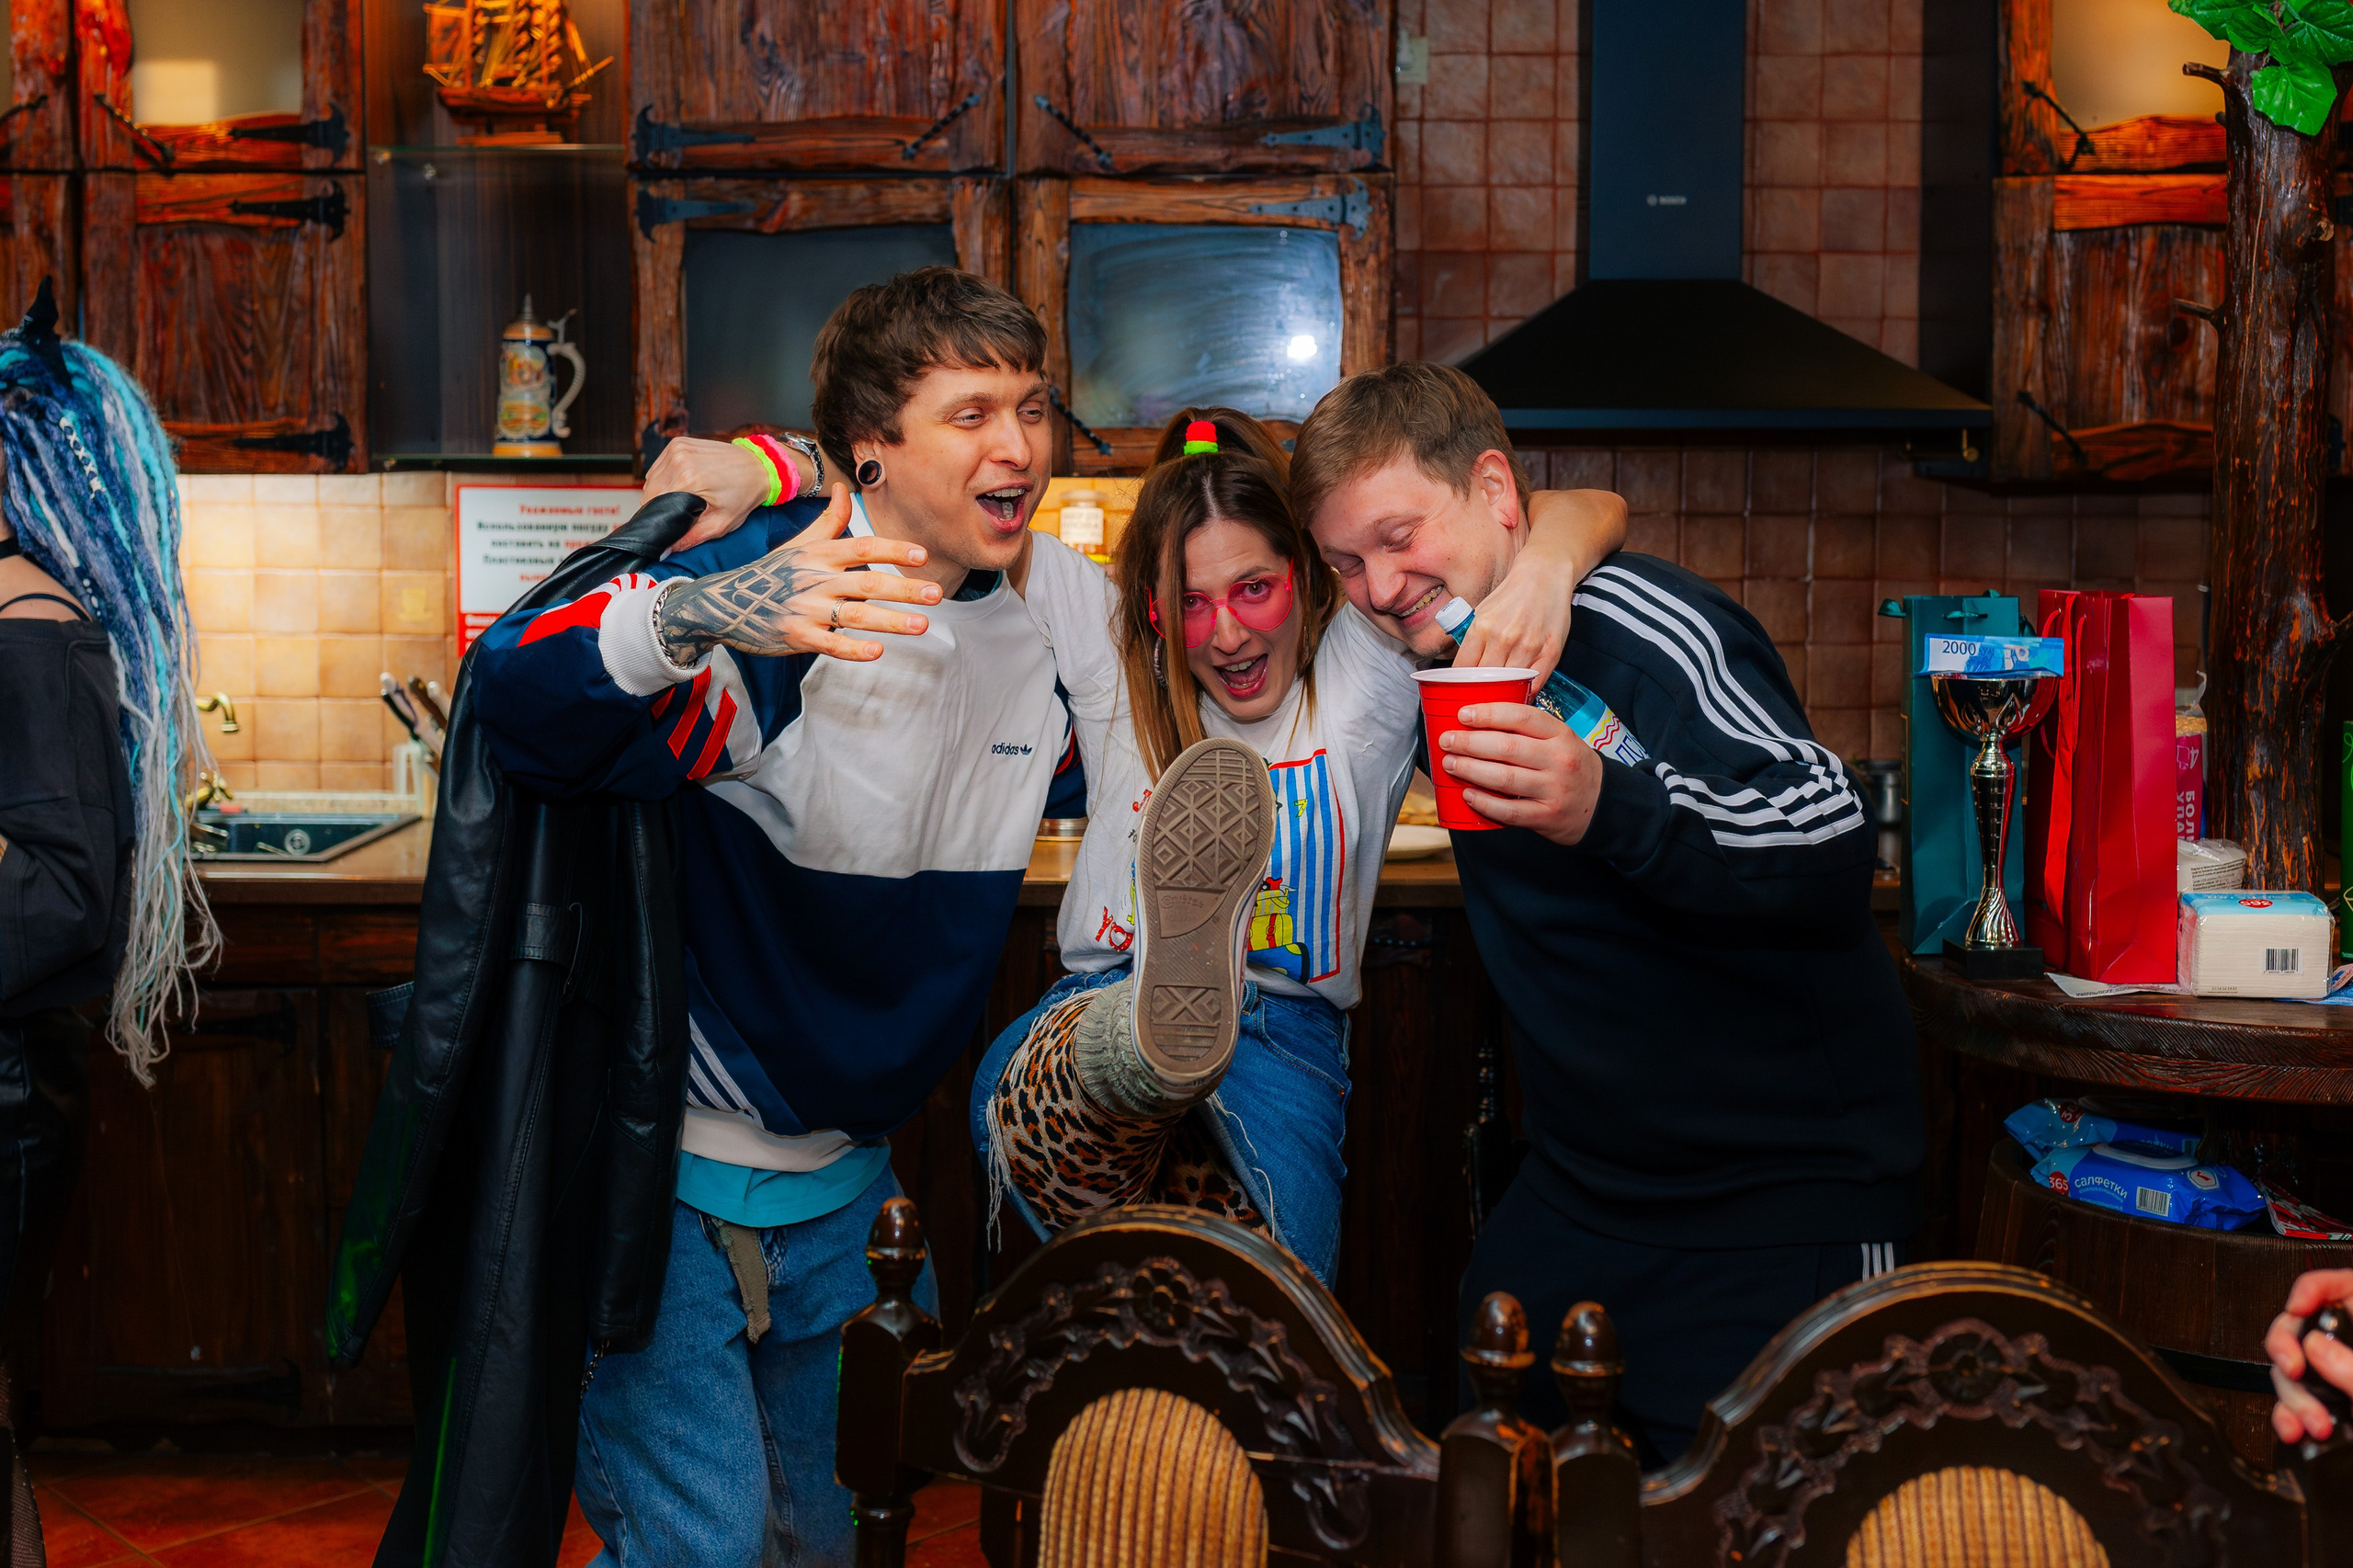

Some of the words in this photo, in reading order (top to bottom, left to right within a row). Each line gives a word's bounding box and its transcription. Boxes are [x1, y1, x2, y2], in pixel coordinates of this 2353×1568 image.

[1942, 641, 1976, 655] 2000
[992, 742, 1019, 756] adidas
[2049, 1176, 2069, 1191] 365
